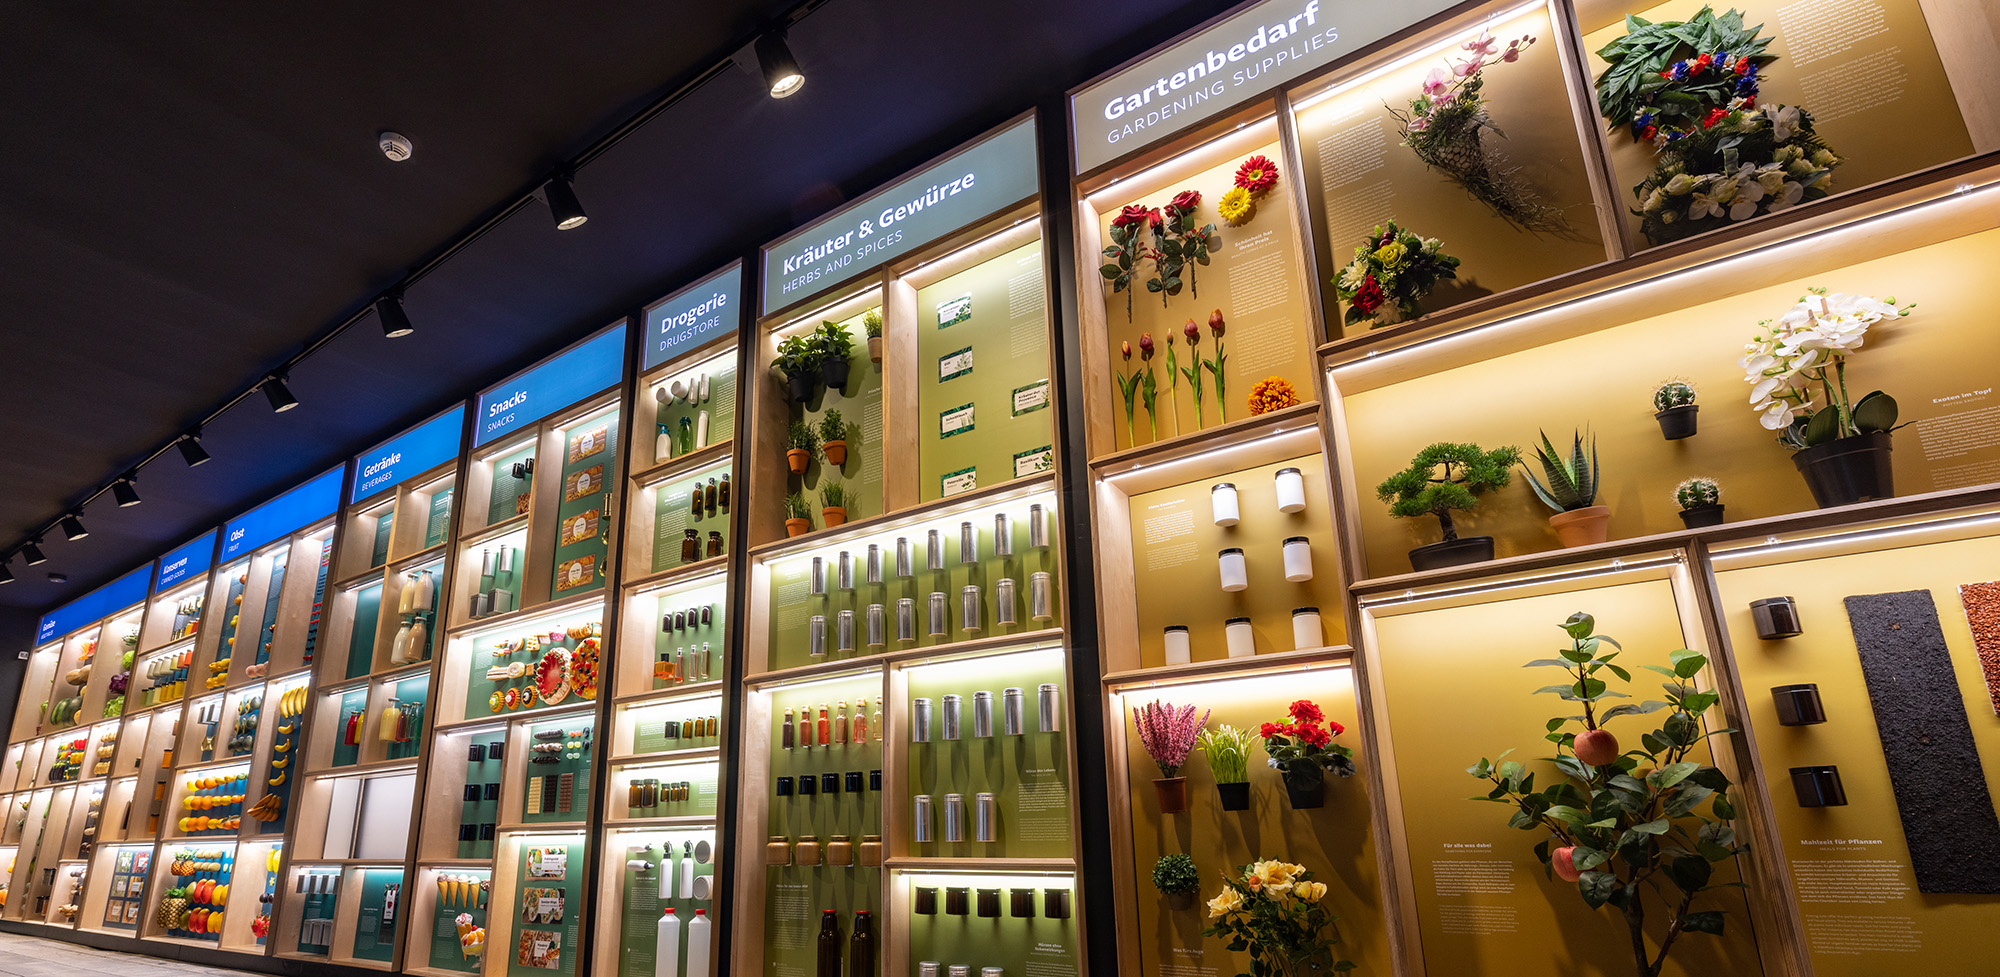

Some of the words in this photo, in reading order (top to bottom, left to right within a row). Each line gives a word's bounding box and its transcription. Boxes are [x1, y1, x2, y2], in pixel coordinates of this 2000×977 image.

[1104, 0, 1319, 120] Gartenbedarf
[1107, 80, 1225, 144] GARDENING
[1234, 26, 1338, 86] SUPPLIES
[783, 229, 854, 276] Kräuter
[859, 219, 874, 238] &
[879, 172, 975, 228] Gewürze
[783, 268, 821, 295] HERBS
[825, 252, 853, 274] AND
[857, 230, 903, 260] SPICES
[661, 292, 726, 334] Drogerie
[660, 316, 720, 351] DRUGSTORE
[489, 389, 527, 418] Snacks
[1932, 394, 1960, 404] Exoten
[1973, 387, 1992, 397] Topf
[487, 412, 515, 433] SNACKS
[364, 452, 401, 478] Getränke
[361, 470, 392, 491] BEVERAGES
[230, 527, 245, 542] Obst
[228, 543, 240, 553] FRUIT
[162, 557, 188, 575] Konserven
[173, 568, 186, 580] GOODS
